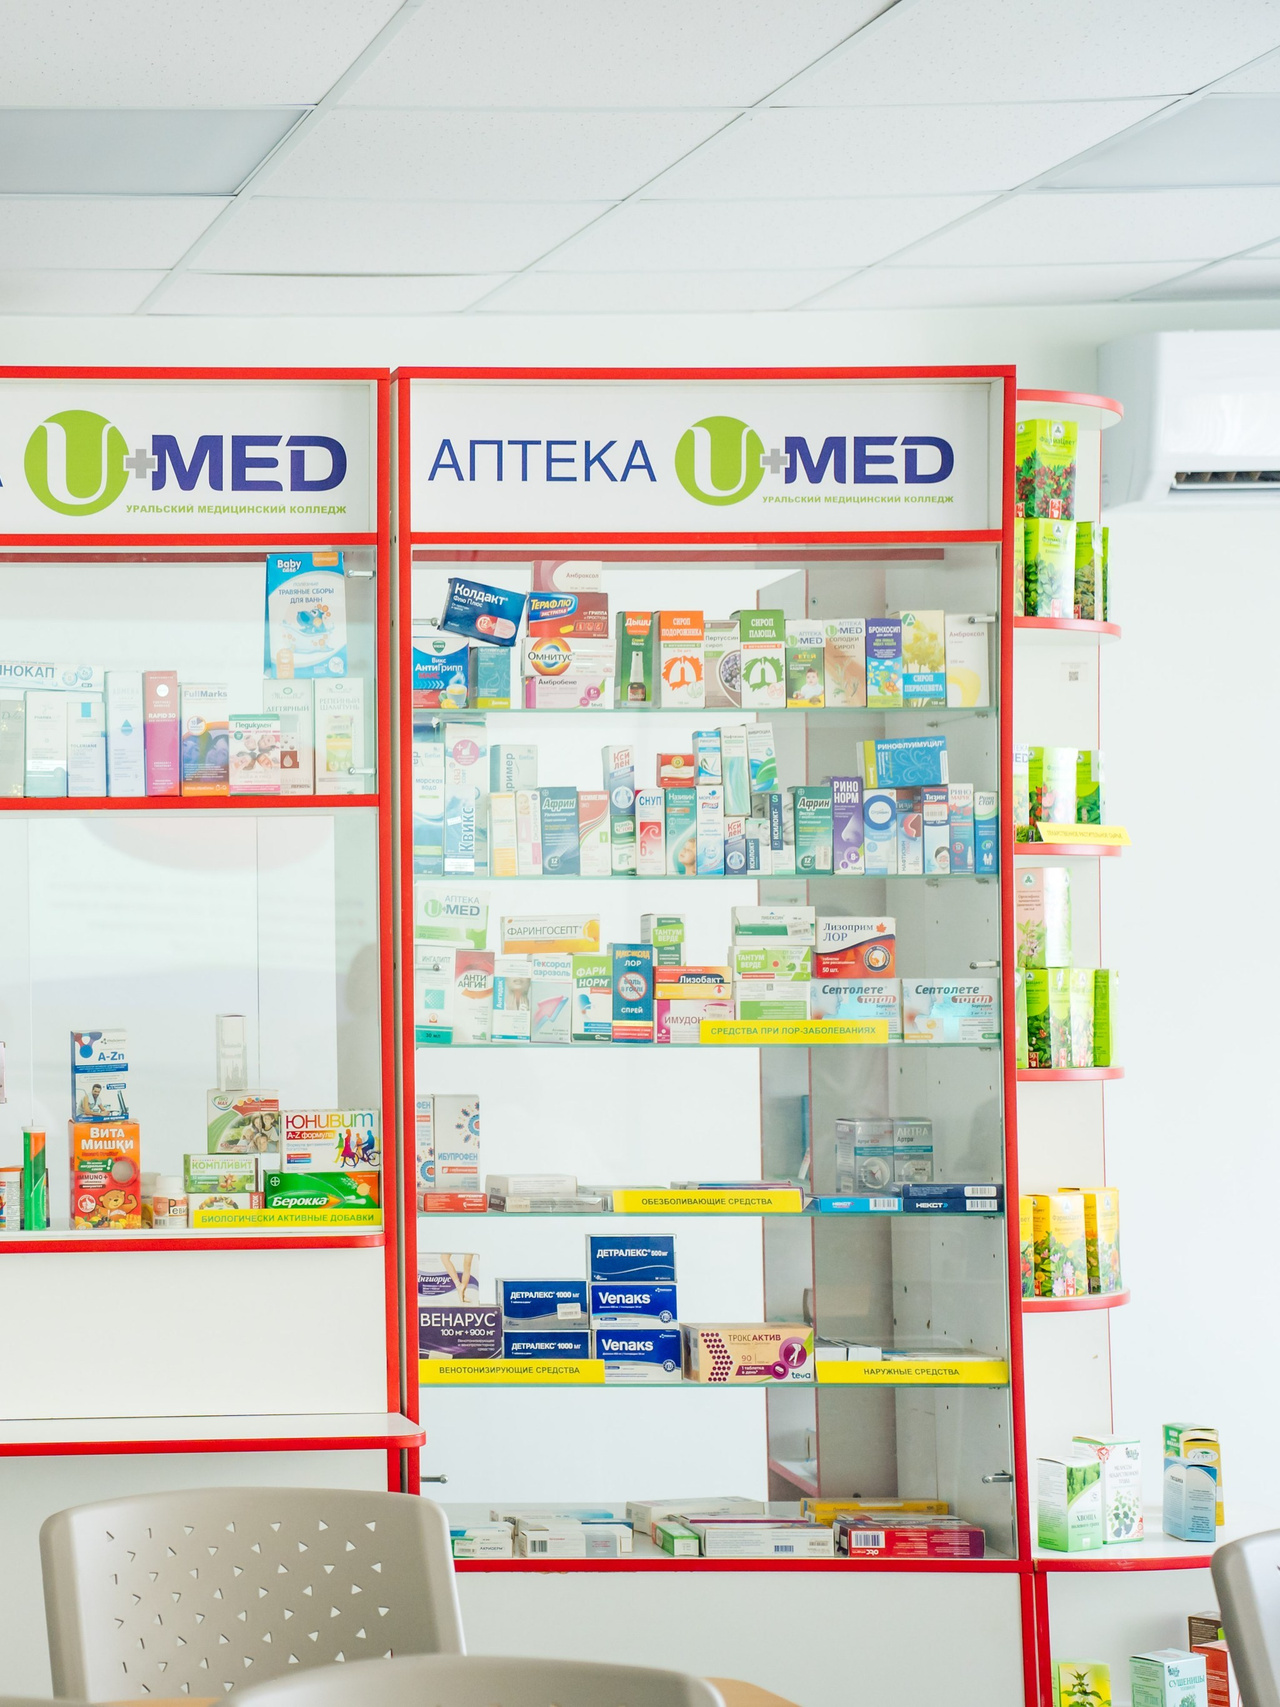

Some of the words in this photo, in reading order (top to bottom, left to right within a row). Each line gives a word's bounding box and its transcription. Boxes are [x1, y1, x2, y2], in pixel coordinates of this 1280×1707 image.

[427, 439, 656, 483] АПТЕКА
[762, 495, 820, 503] УРАЛЬСКИЙ
[825, 495, 900, 503] МЕДИЦИНСКИЙ
[904, 495, 955, 505] КОЛЛЕДЖ
[125, 504, 193, 515] УРАЛЬСКИЙ
[197, 503, 285, 515] МЕДИЦИНСКИЙ
[290, 504, 346, 515] КОЛЛЕДЖ
[278, 559, 301, 572] Baby
[749, 630, 776, 638] ПЛЮЩА
[528, 652, 572, 663] Омнитус
[834, 781, 859, 792] РИНО
[639, 796, 662, 806] СНУП
[834, 792, 859, 803] НОРМ
[543, 798, 576, 809] Африн
[799, 798, 830, 809] Африн
[824, 923, 873, 932] Лизоприм
[823, 933, 848, 941] ЛОР
[533, 959, 570, 969] Гексорал
[576, 967, 606, 976] ФАРИ
[579, 979, 609, 987] НОРМ
[679, 976, 721, 984] Лизобакт
[822, 985, 884, 995] Септолете
[915, 985, 979, 995] Септолете
[711, 1027, 758, 1035] СРЕДСТВА
[761, 1027, 779, 1035] ПРИ
[782, 1026, 876, 1035] ЛОР-ЗАБОЛЕВАНИЯХ
[438, 1152, 478, 1161] ИБУПРОФЕН
[192, 1162, 252, 1170] КОМПЛИВИТ
[272, 1196, 328, 1208] Берокка
[641, 1198, 726, 1206] ОБЕЗБОЛИВАЮЩИЕ
[728, 1198, 773, 1206] СРЕДСТВА
[201, 1215, 275, 1223] БИОЛОГИЧЕСКИ
[277, 1214, 328, 1222] АКТИВНЫЕ
[330, 1214, 374, 1222] ДОБАВКИ
[599, 1292, 650, 1305] Venaks
[421, 1313, 496, 1327] ВЕНАРУС
[602, 1339, 654, 1351] Venaks
[439, 1366, 534, 1375] ВЕНОТОНИЗИРУЮЩИЕ
[536, 1366, 580, 1375] СРЕДСТВА
[864, 1368, 912, 1376] НАРУЖНЫЕ
[915, 1367, 959, 1376] СРЕДСТВА
